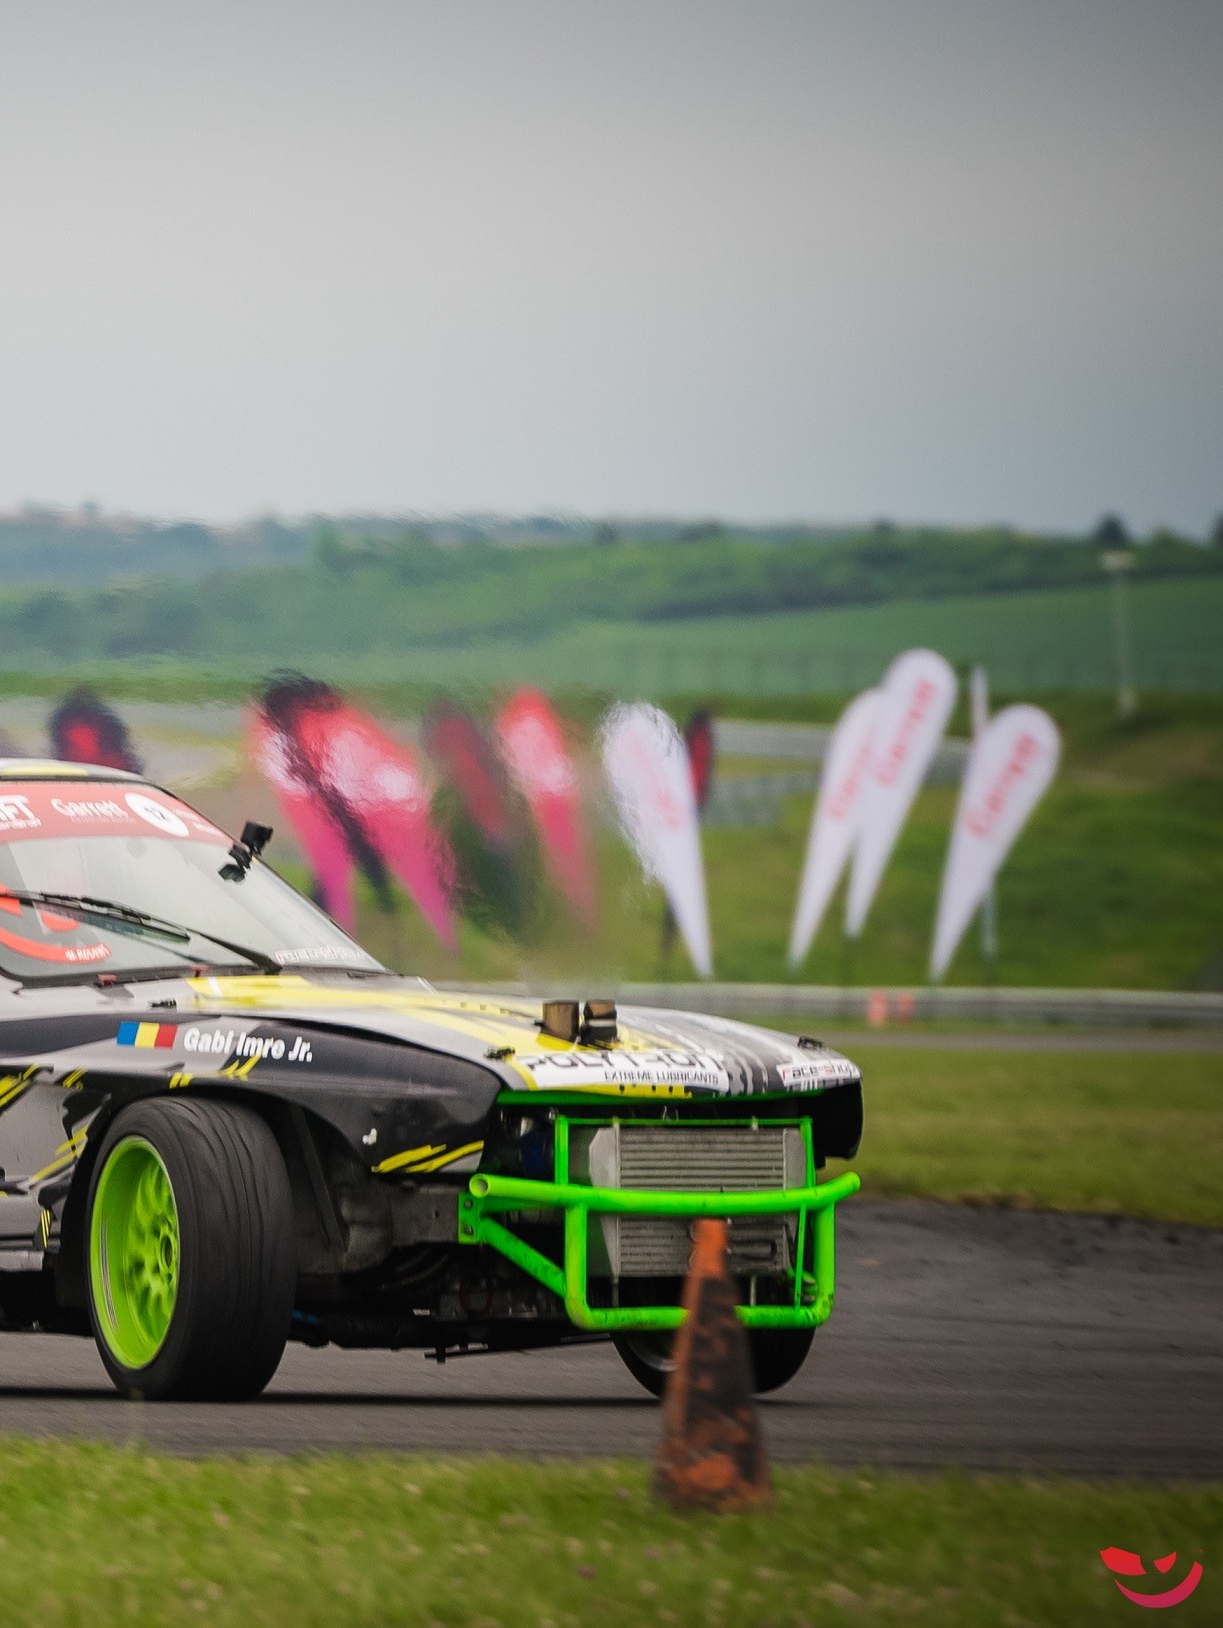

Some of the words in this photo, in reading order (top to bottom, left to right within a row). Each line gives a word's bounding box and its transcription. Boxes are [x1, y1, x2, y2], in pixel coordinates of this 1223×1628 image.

[183, 1027, 234, 1054] Gabi
[288, 1036, 313, 1063] Jr.
[604, 1071, 654, 1083] EXTREME
[656, 1071, 720, 1085] LUBRICANTS
